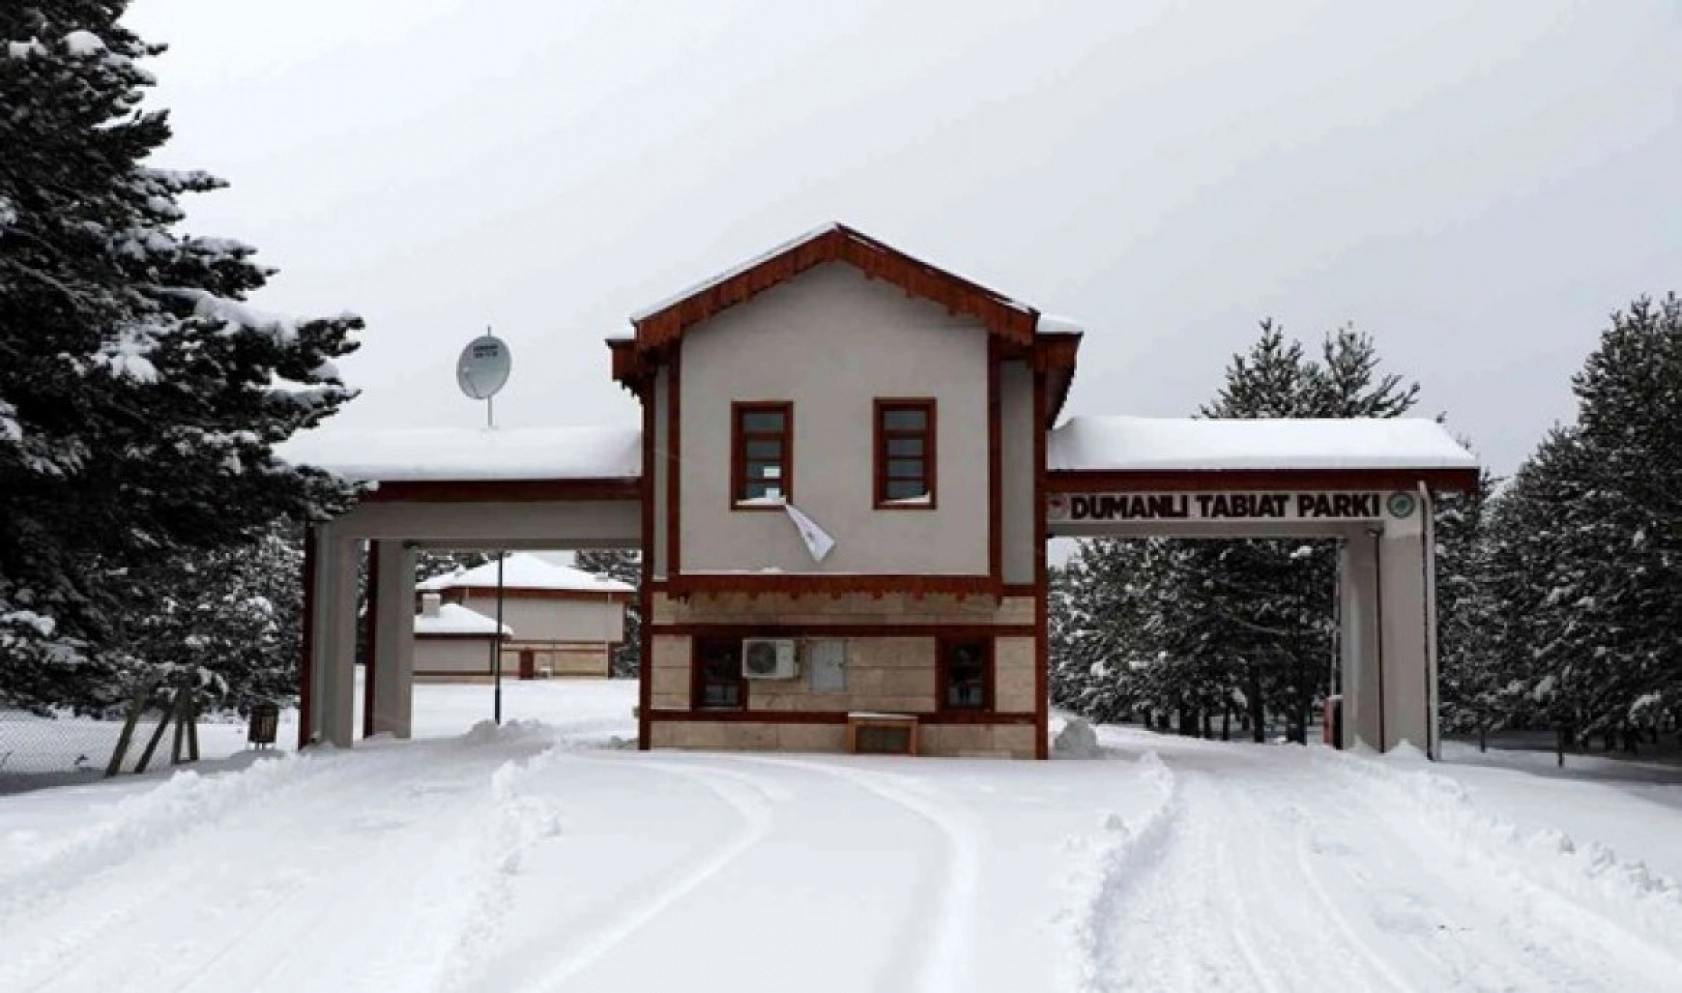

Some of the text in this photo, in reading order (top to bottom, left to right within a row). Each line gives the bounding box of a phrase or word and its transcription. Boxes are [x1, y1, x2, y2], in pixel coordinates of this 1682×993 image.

[1071, 494, 1380, 519] DUMANLI TABIAT PARKI
